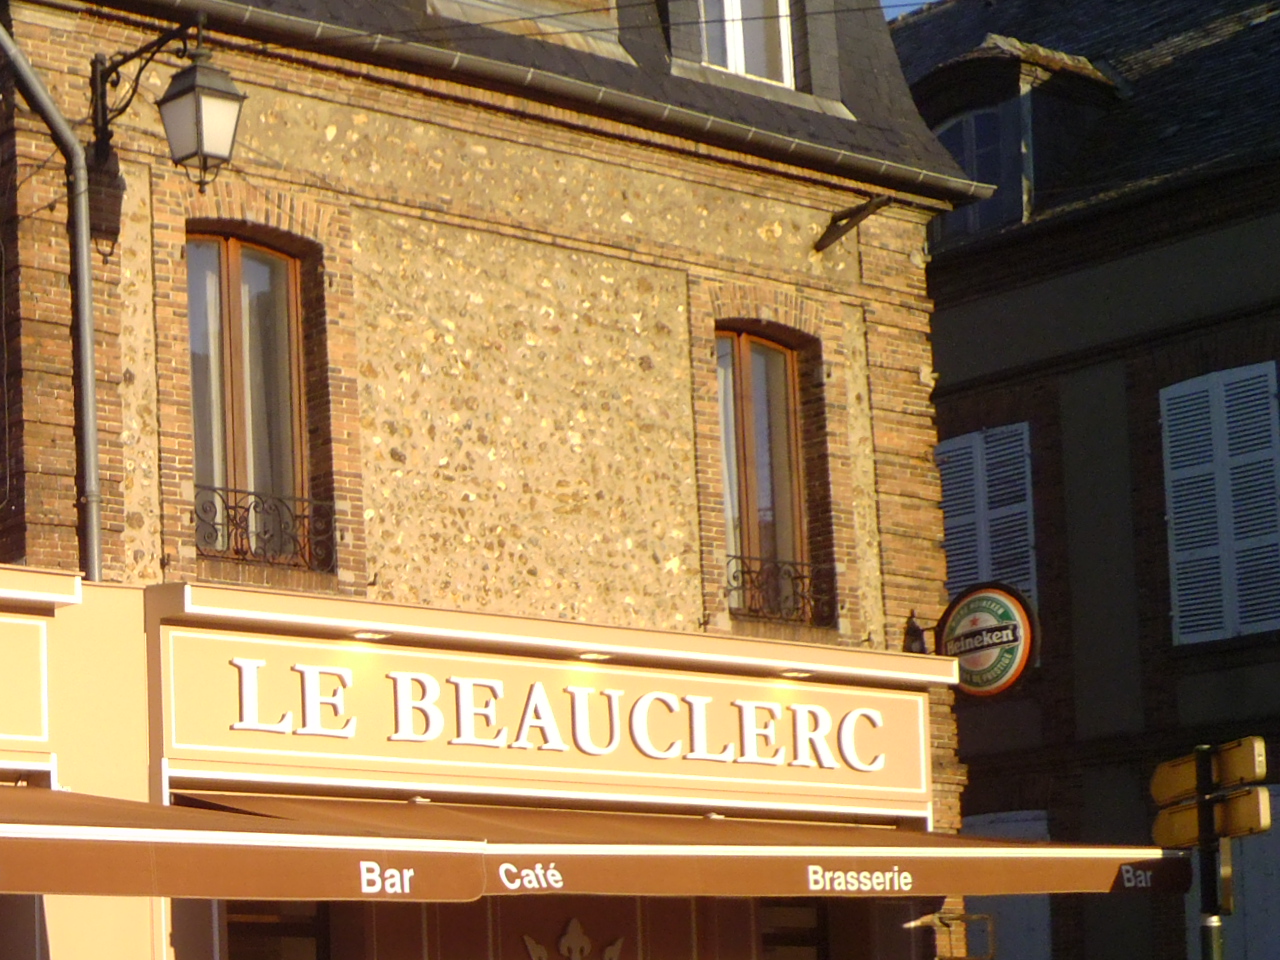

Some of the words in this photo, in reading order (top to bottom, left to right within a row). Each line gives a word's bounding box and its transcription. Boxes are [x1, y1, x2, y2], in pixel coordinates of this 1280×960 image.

[946, 627, 1014, 656] Heineken
[229, 657, 357, 739] LE
[386, 670, 886, 773] BEAUCLERC
[359, 860, 414, 894] Bar
[498, 862, 564, 890] Café
[807, 865, 913, 891] Brasserie
[1121, 866, 1153, 888] Bar
